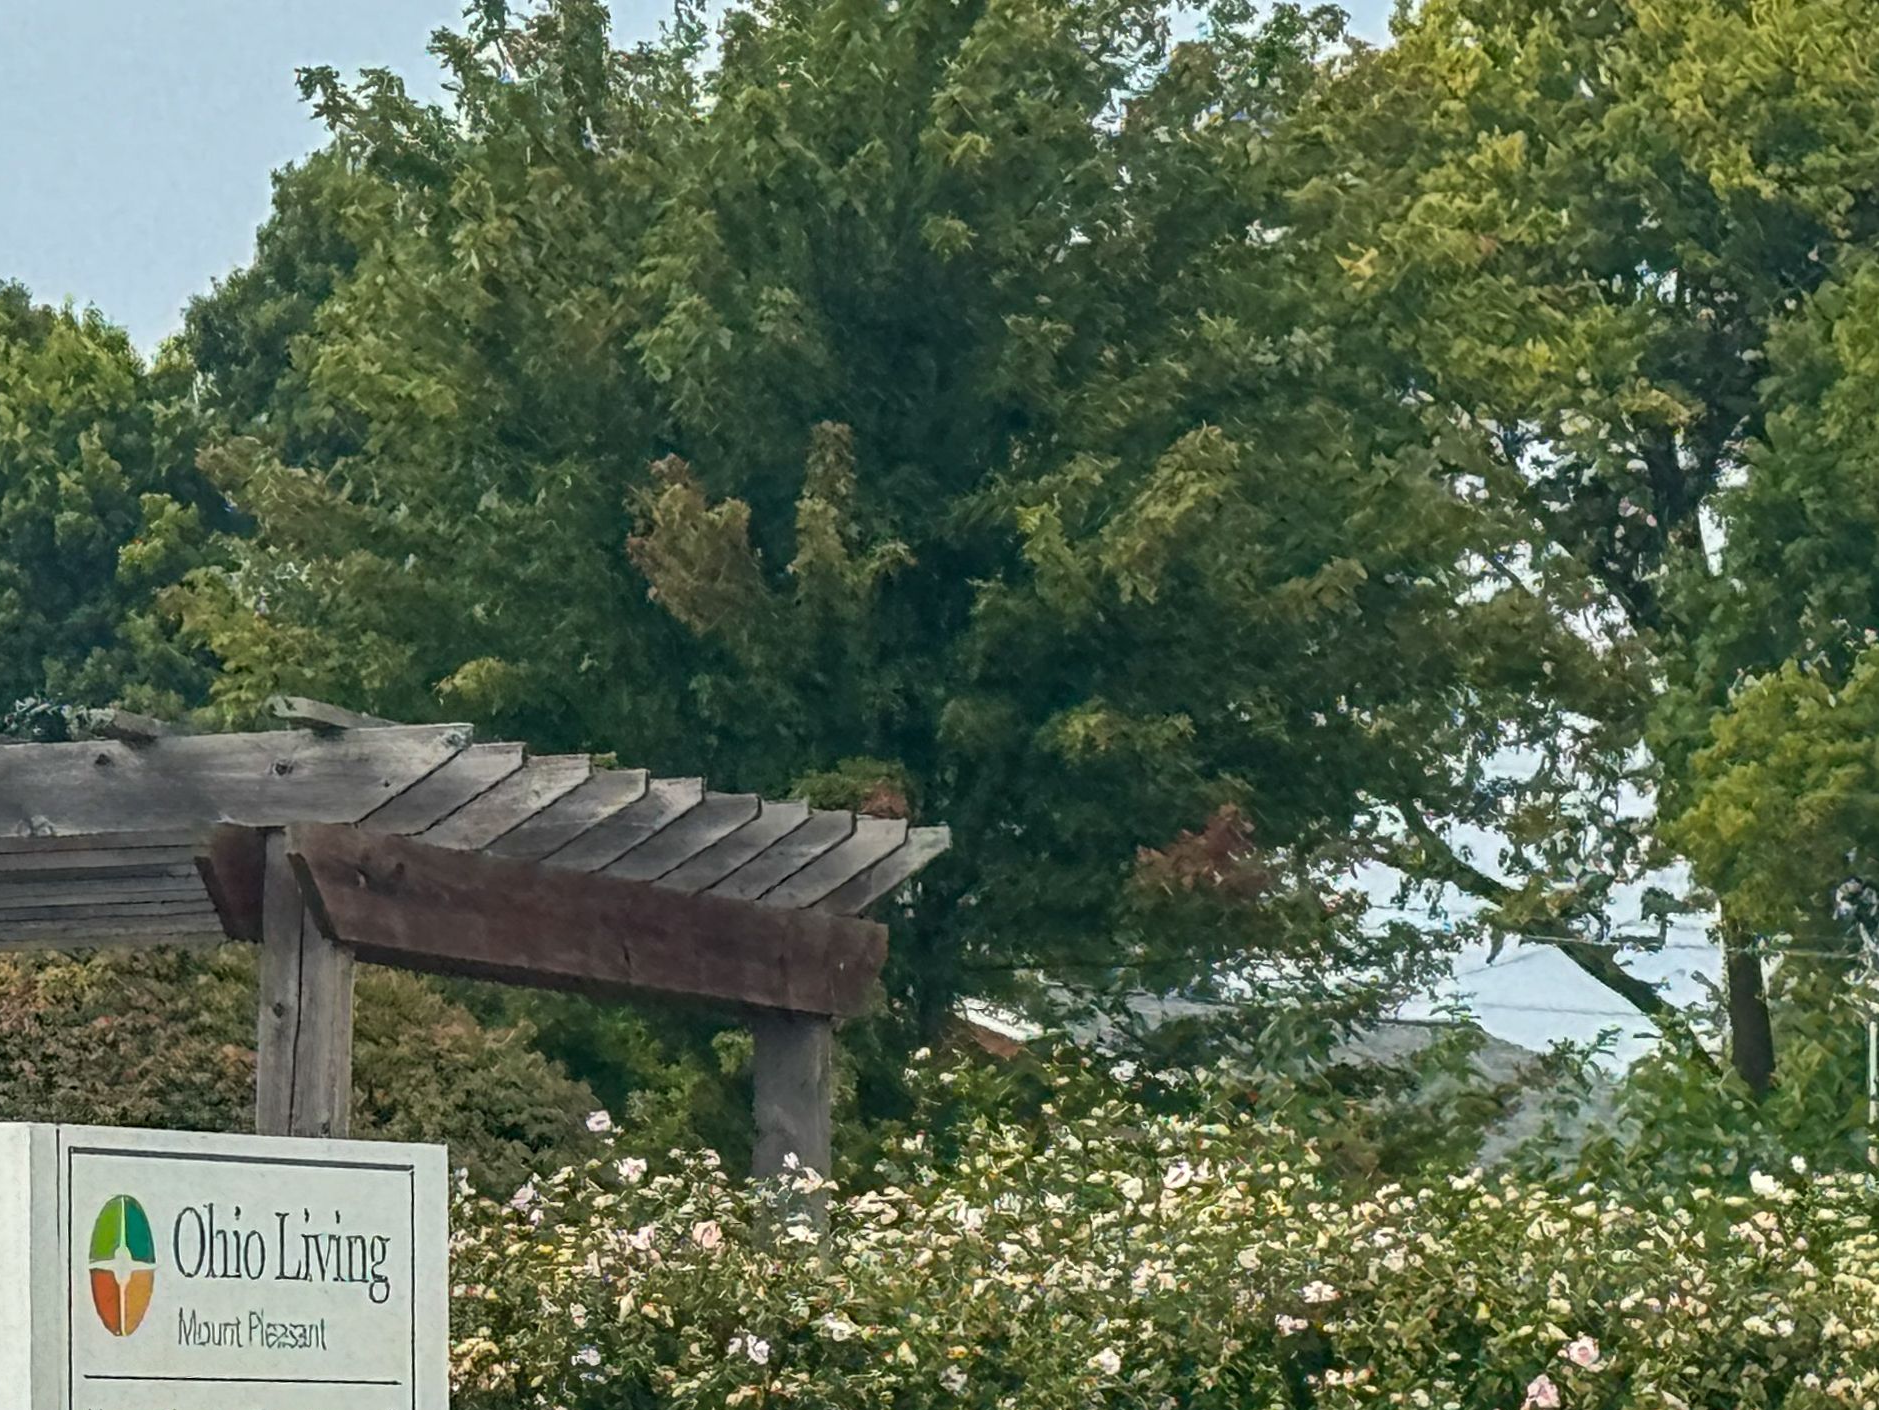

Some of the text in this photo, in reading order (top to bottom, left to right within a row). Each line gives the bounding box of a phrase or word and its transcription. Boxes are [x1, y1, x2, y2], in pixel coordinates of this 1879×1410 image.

[173, 1203, 391, 1304] Ohio Living
[178, 1307, 326, 1350] Mount Pleasant
